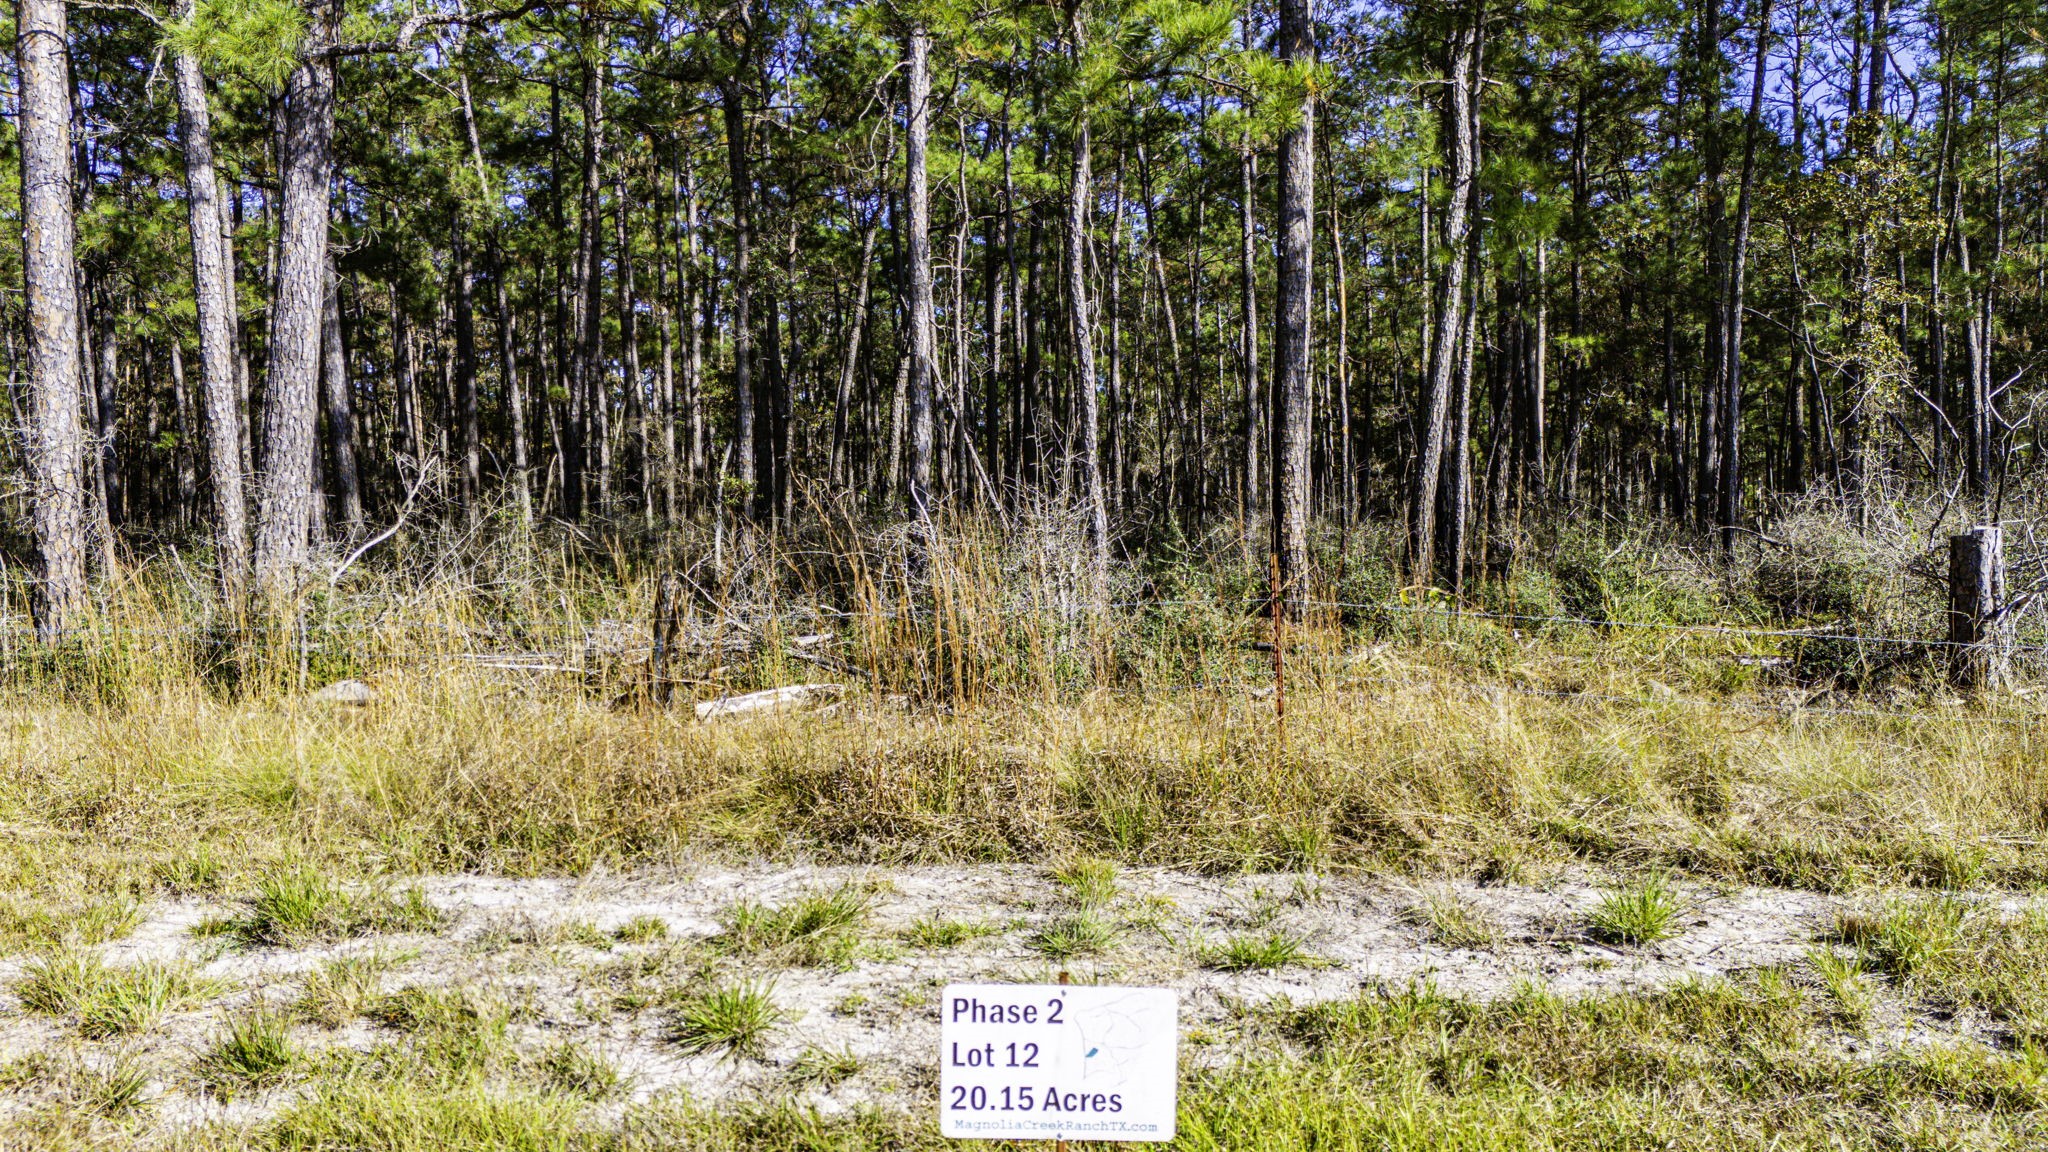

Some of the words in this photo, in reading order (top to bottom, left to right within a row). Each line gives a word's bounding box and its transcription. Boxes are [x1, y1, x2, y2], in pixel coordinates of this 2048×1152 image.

[952, 998, 1038, 1024] Phase
[1047, 998, 1064, 1024] 2
[952, 1042, 995, 1067] Lot
[1006, 1042, 1039, 1067] 12
[951, 1085, 1034, 1111] 20.15
[1042, 1086, 1123, 1113] Acres
[954, 1119, 1158, 1133] MagnoliaCreekRanchTX.com
